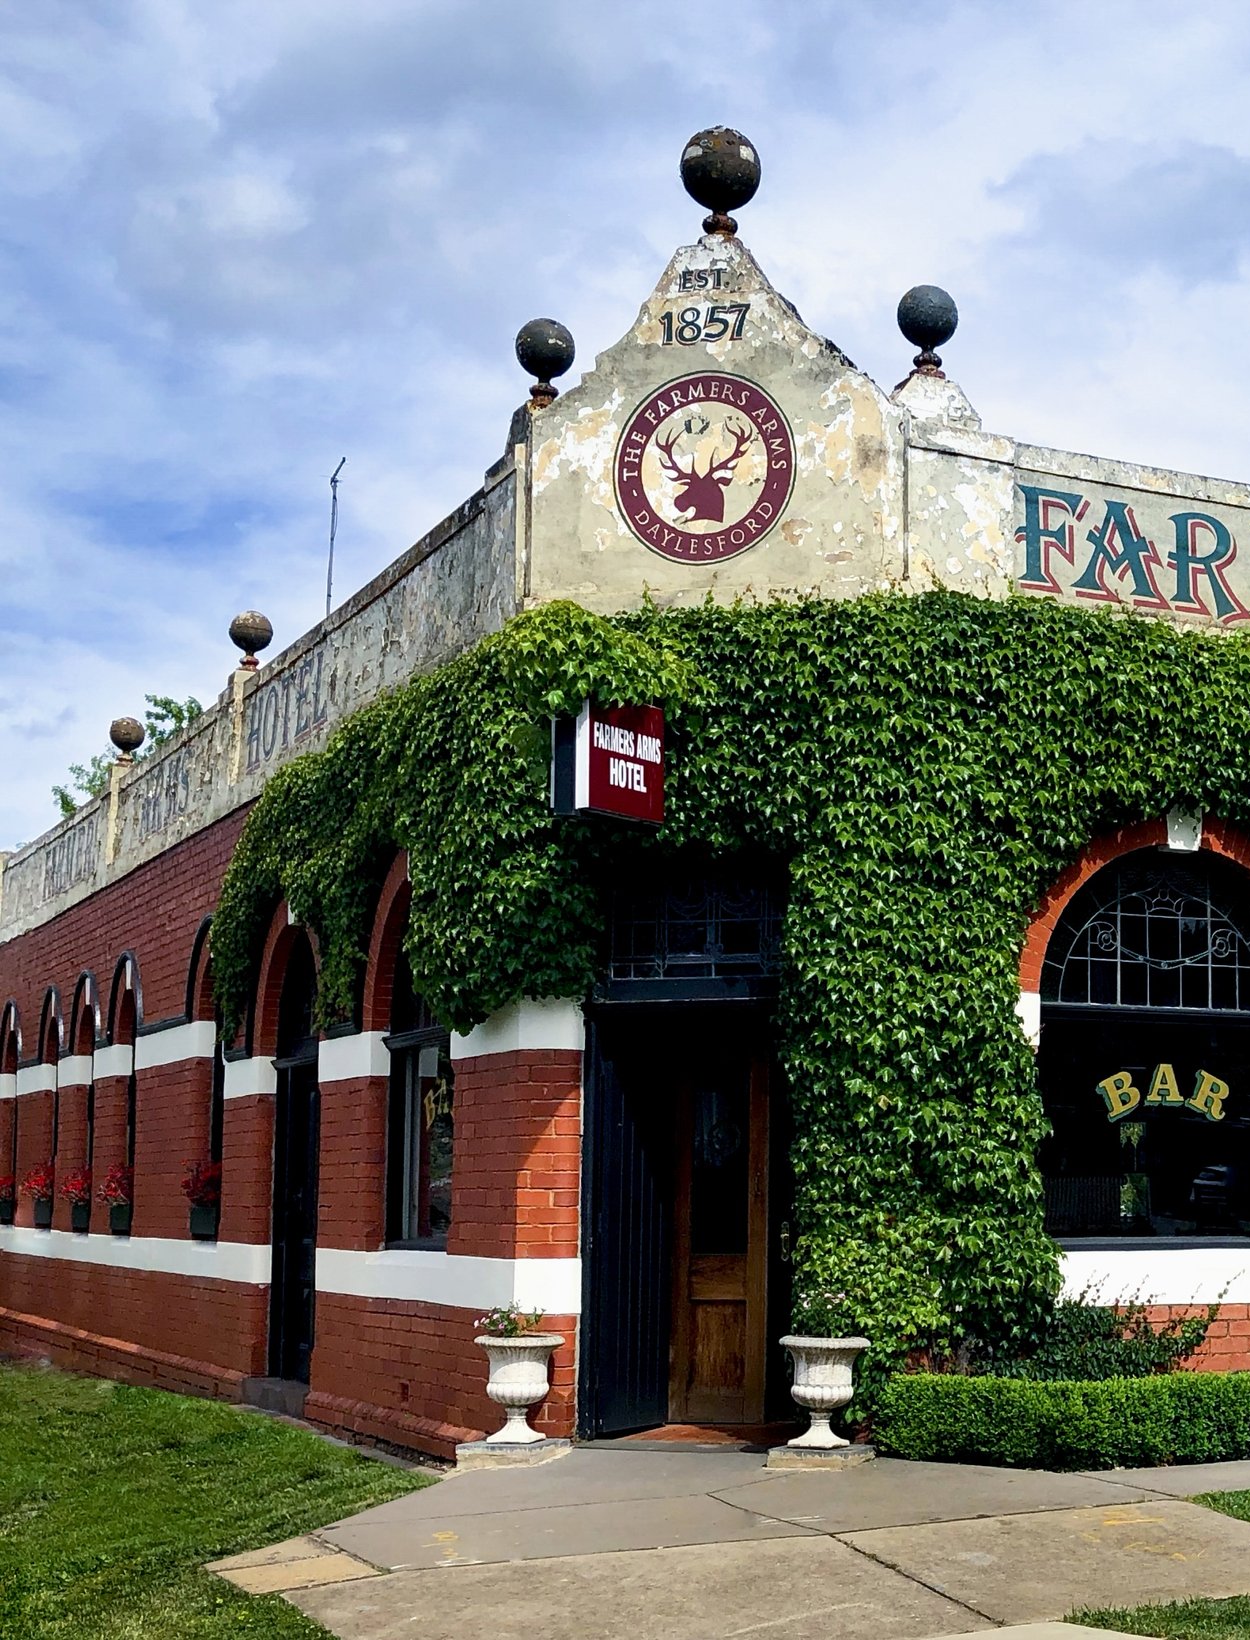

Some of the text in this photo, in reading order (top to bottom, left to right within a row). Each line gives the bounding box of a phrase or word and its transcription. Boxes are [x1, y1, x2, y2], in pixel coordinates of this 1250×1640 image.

[659, 303, 751, 346] 1857
[623, 381, 787, 481] THE FARMERS ARMS
[634, 501, 773, 555] DAYLESFORD
[246, 650, 328, 775] HOTEL
[594, 721, 661, 765] FARMERS ARMS
[609, 757, 647, 793] HOTEL
[423, 1078, 455, 1131] BA
[1095, 1063, 1230, 1123] BAR
